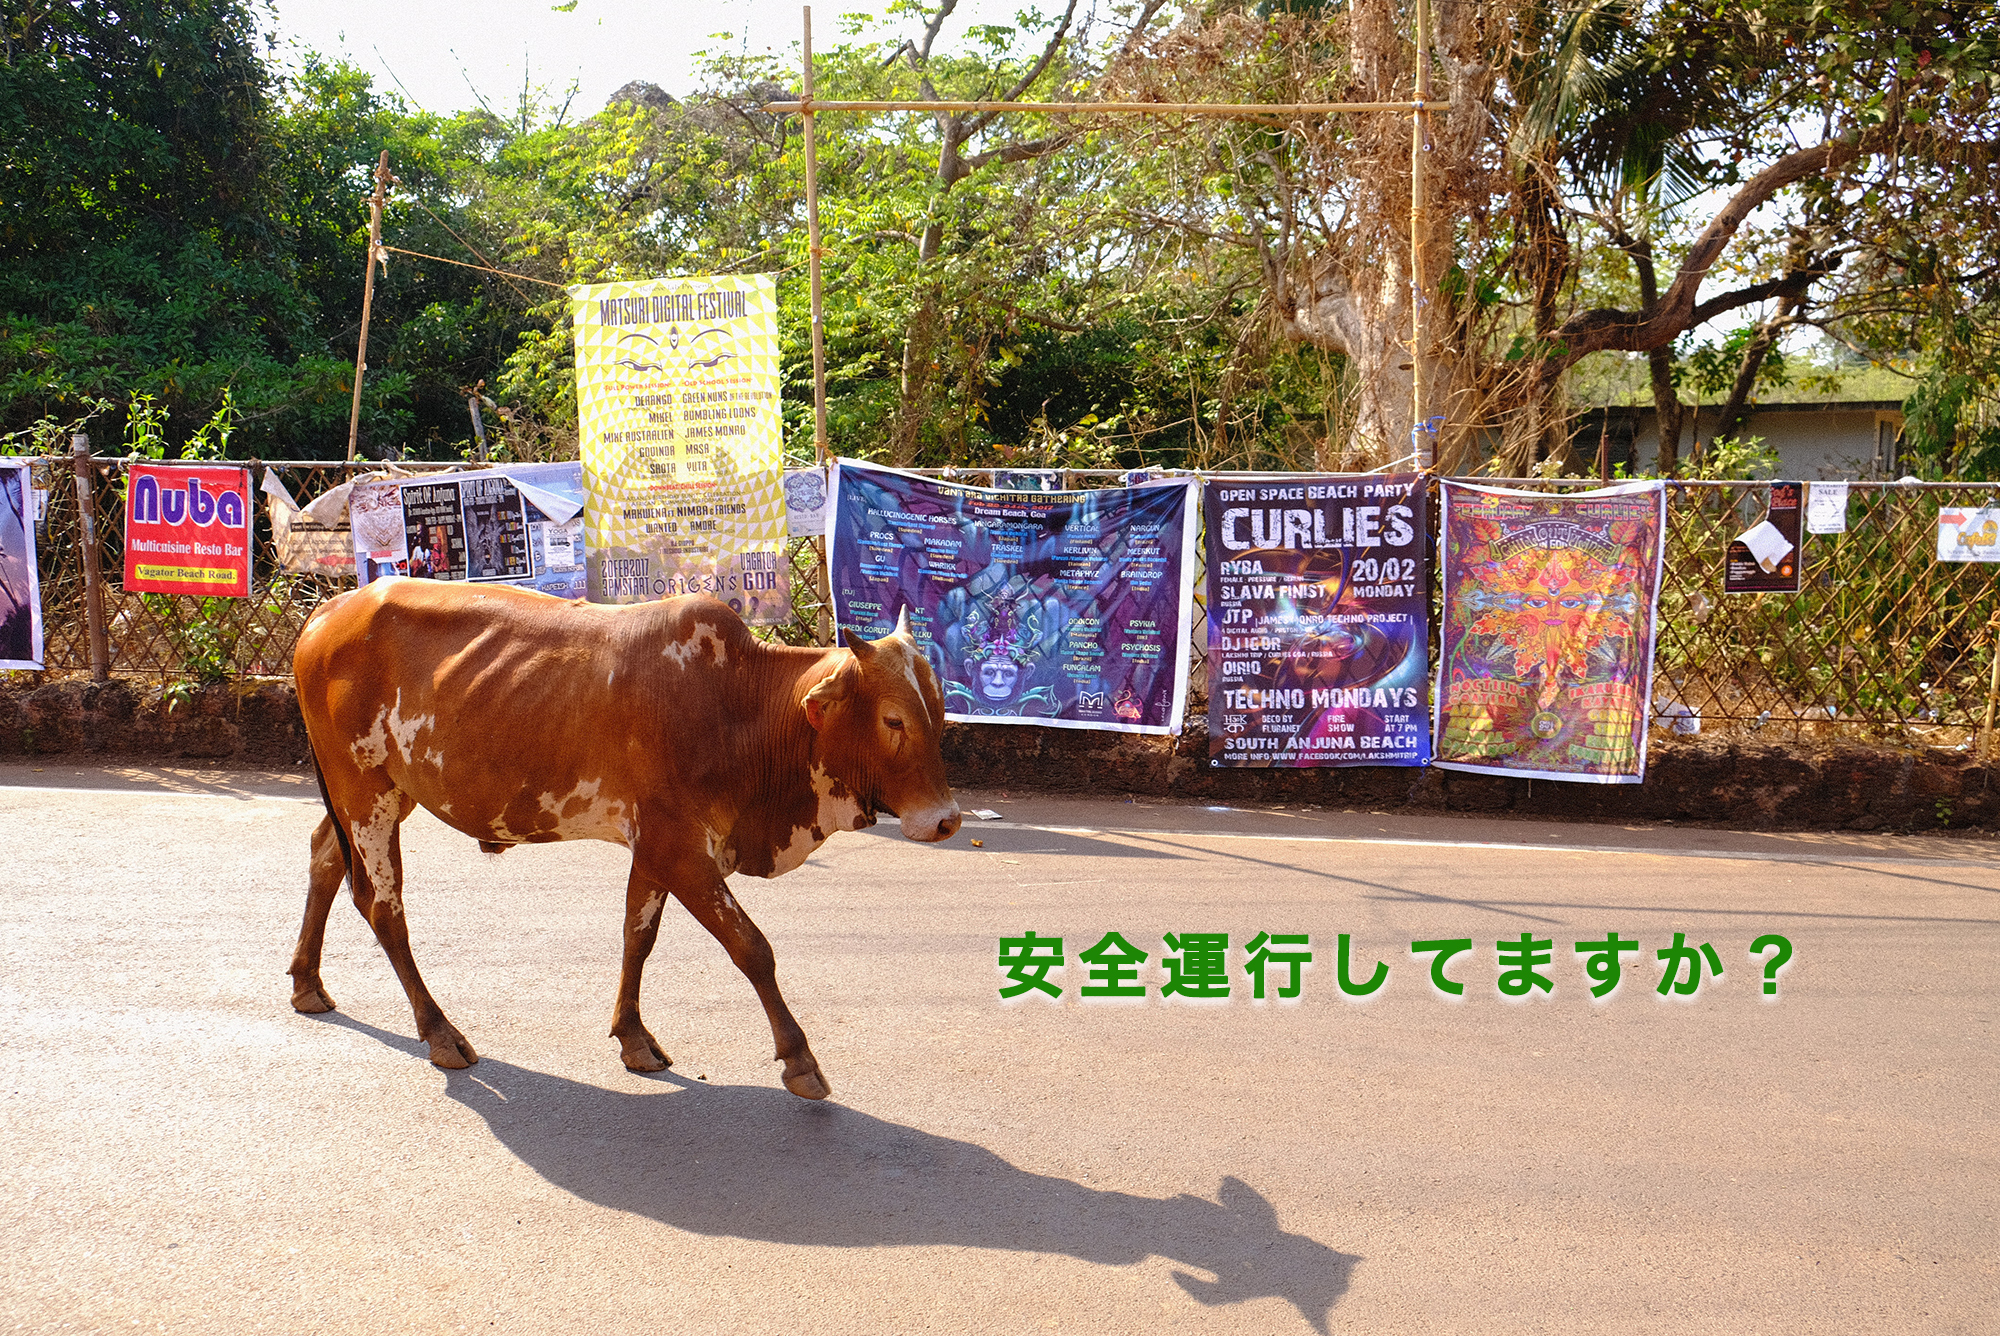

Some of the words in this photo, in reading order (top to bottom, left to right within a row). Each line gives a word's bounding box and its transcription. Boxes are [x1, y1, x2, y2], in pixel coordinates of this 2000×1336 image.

[600, 297, 649, 327] MATSURI
[652, 293, 694, 323] DIGITAL
[698, 290, 748, 320] FESTIVAL
[682, 392, 706, 403] GREEN
[707, 391, 728, 402] NUNS
[683, 408, 727, 421] BUMBLING
[729, 407, 756, 419] LOONS
[603, 431, 623, 443] MIKE
[626, 429, 675, 442] AUSTRALIEN
[684, 426, 713, 438] JAMES
[685, 443, 710, 455] MASA
[686, 461, 707, 472] YUTA
[1220, 489, 1257, 502] OPEN
[1259, 487, 1304, 501] SPACE
[1307, 485, 1357, 499] BEACH
[1363, 483, 1415, 498] PARTY
[133, 474, 245, 528] Nuba
[623, 506, 667, 520] MAKWENA
[676, 505, 708, 518] NIMBA
[715, 503, 746, 515] FRIENDS
[867, 507, 927, 522] HALLUCINOGENIC
[928, 515, 957, 525] HORSES
[974, 507, 1001, 516] Dream
[1030, 511, 1047, 519] Goa
[646, 522, 677, 534] WANTED
[690, 520, 716, 532] AMORE
[1065, 524, 1099, 532] VERTICAL
[1221, 504, 1414, 550] CURLIES
[870, 531, 894, 540] PROCS
[131, 538, 191, 554] Multicuisine
[194, 542, 222, 556] Resto
[224, 543, 243, 557] Bar
[924, 537, 962, 548] MAKADAM
[740, 551, 777, 571] VAGATOR
[875, 555, 886, 563] GU
[137, 566, 174, 578] Vagator
[177, 568, 205, 579] Beach
[208, 569, 236, 580] Road.
[1220, 560, 1264, 575] RYBA
[1352, 557, 1416, 585] 20/02
[1121, 570, 1163, 579] BRAINDROP
[743, 571, 777, 591] GOA
[1220, 584, 1275, 600] SLAVA
[1279, 584, 1326, 599] FINIST
[1353, 584, 1415, 598] MONDAY
[848, 600, 882, 611] GIUSEPPE
[1222, 608, 1253, 624] JTP
[1327, 614, 1364, 624] TECHNO
[1367, 613, 1408, 623] PROJECT
[1069, 641, 1099, 649] PANCHO
[1121, 643, 1161, 652] PSYCHOSIS
[1222, 637, 1242, 651] DJ
[1244, 637, 1281, 651] IGOR
[1063, 664, 1101, 672] FUNGALAM
[1223, 688, 1305, 710] TECHNO
[1311, 687, 1418, 709] MONDAYS
[1262, 714, 1281, 723] DECO
[1281, 714, 1293, 723] BY
[1327, 714, 1345, 723] FIRE
[1384, 714, 1410, 723] START
[1327, 723, 1355, 732] SHOW
[1384, 724, 1396, 732] AT
[1397, 724, 1403, 732] 7
[1404, 724, 1418, 732] PM
[1224, 737, 1279, 750] SOUTH
[1285, 736, 1356, 750] ANJUNA
[1360, 736, 1417, 749] BEACH
[1224, 753, 1248, 761] MORE
